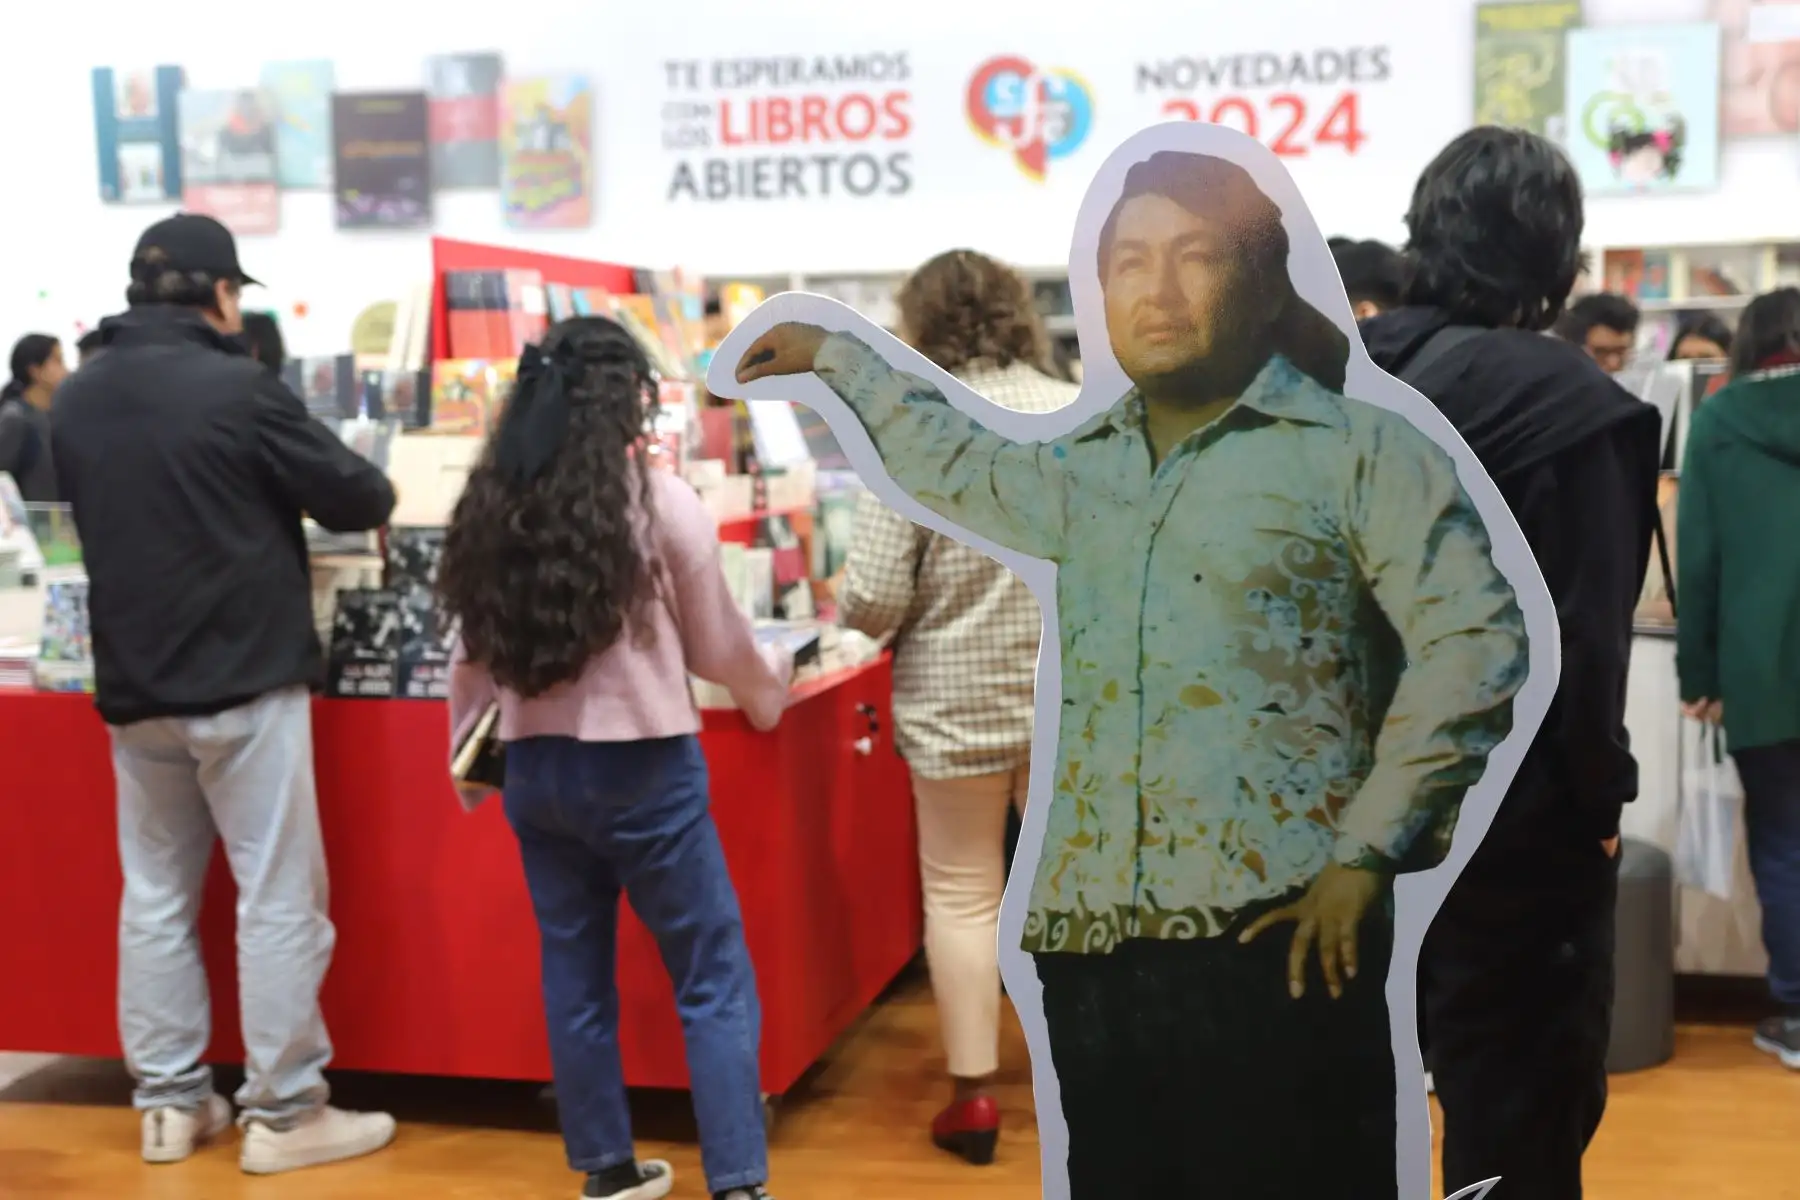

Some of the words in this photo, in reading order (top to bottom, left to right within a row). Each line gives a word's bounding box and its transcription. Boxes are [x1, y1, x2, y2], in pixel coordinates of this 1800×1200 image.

[665, 60, 698, 88] TE
[712, 51, 911, 87] ESPERAMOS
[1135, 47, 1390, 92] NOVEDADES
[720, 91, 912, 144] LIBROS
[666, 153, 912, 201] ABIERTOS
